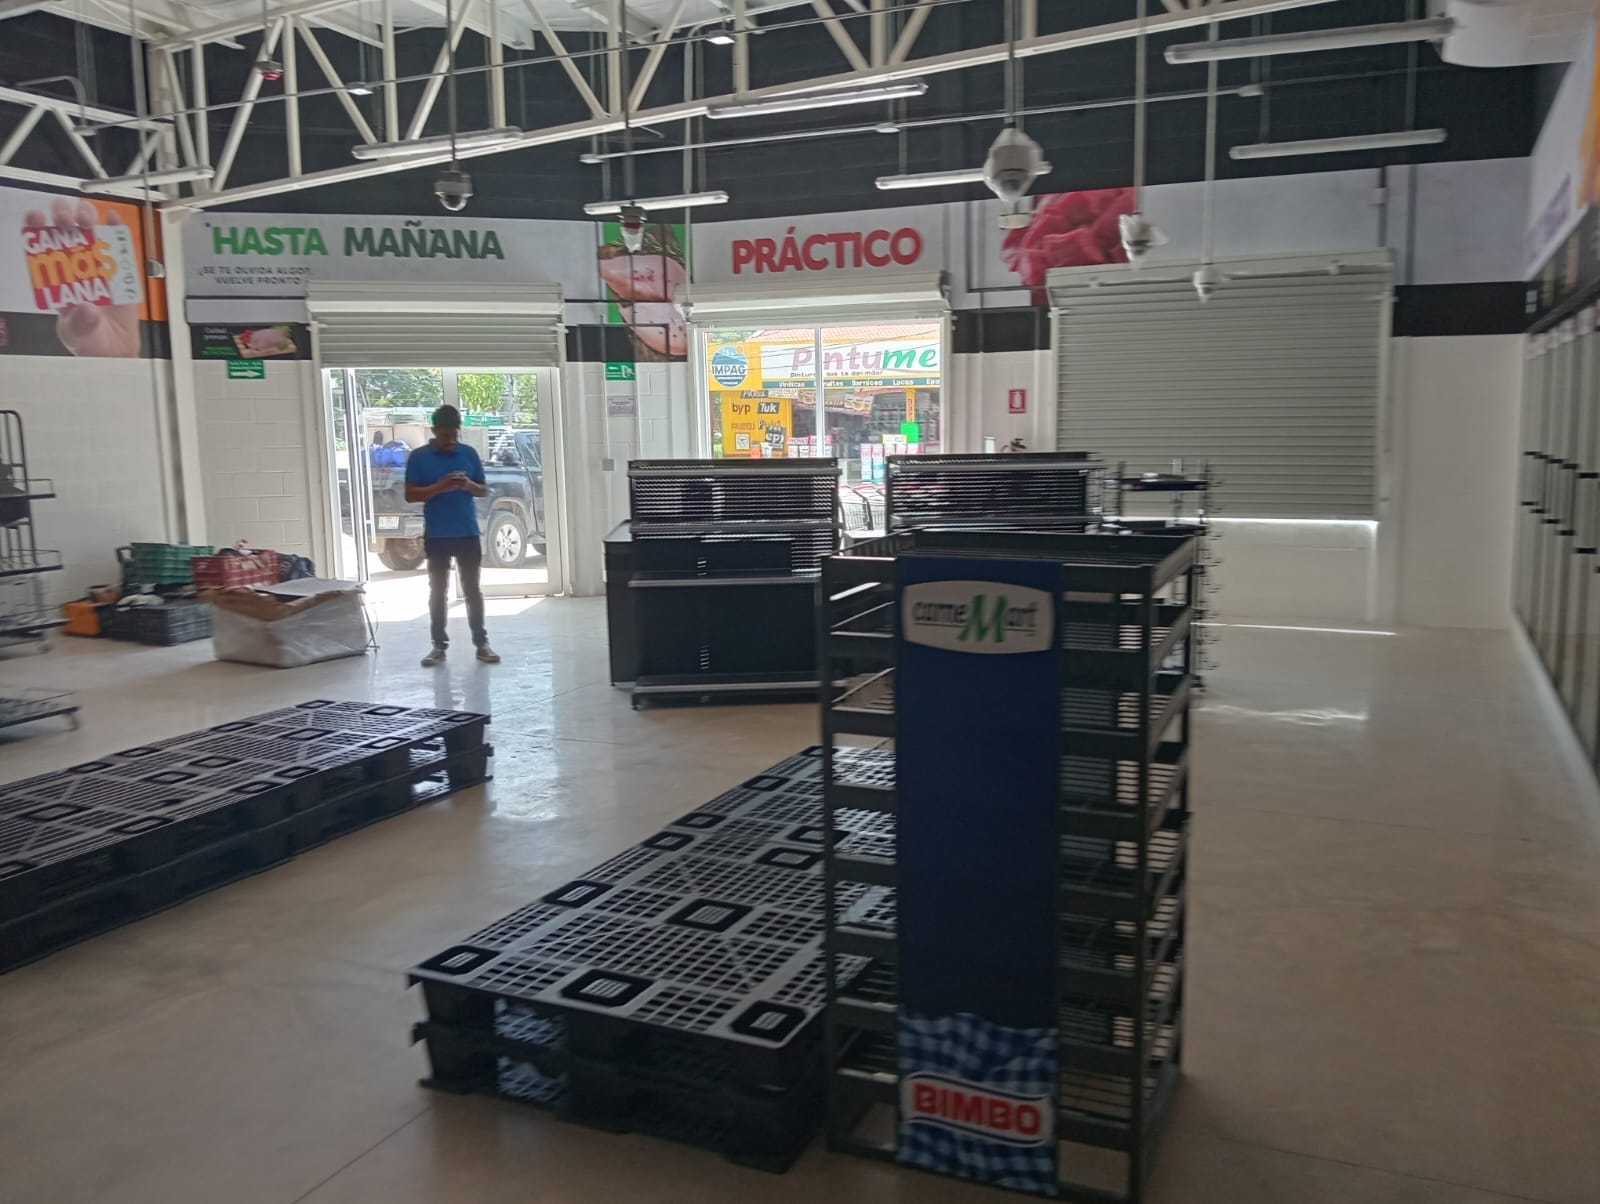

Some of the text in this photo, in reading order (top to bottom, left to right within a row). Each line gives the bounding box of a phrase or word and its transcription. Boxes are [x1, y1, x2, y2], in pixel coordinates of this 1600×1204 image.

[22, 228, 90, 254] GANA
[213, 219, 505, 260] HASTA MAÑANA
[732, 225, 924, 274] PRÁCTICO
[215, 276, 302, 285] VUELVE PRONTO
[233, 266, 272, 275] OLVIDA
[43, 277, 112, 309] LANA
[711, 365, 746, 375] IMPAG
[732, 402, 751, 415] byp
[912, 1083, 1041, 1136] BIMBO
